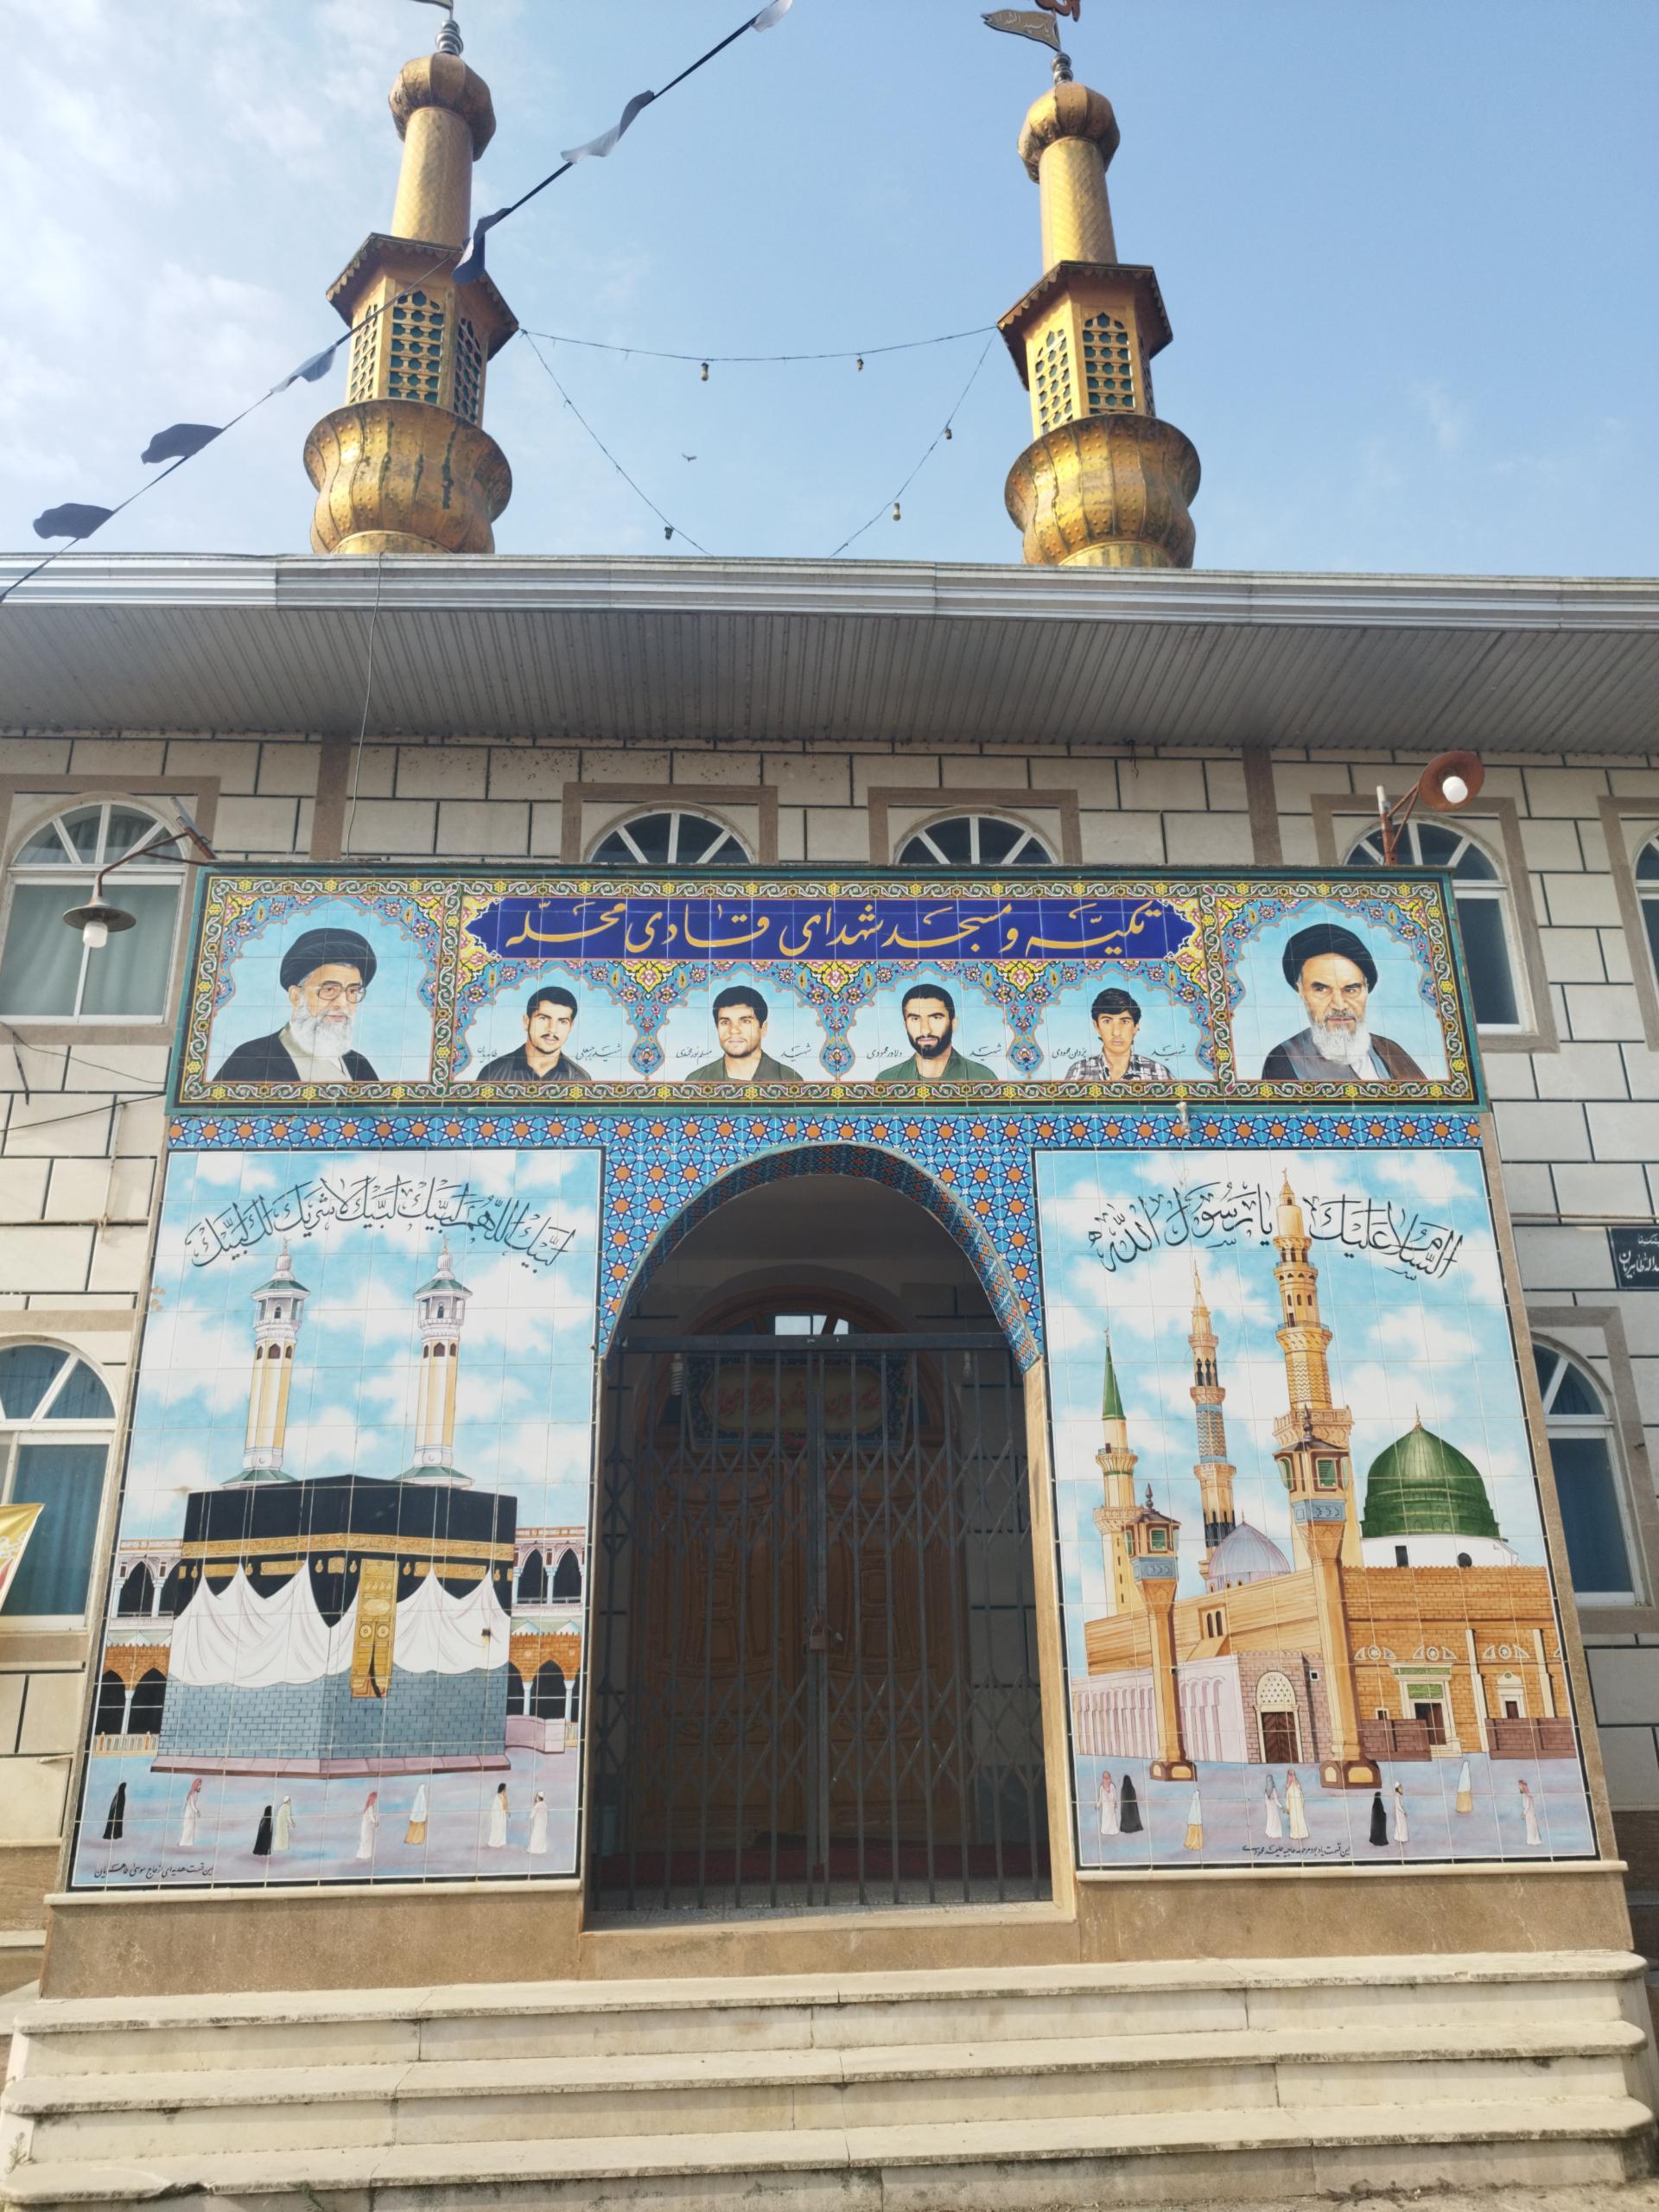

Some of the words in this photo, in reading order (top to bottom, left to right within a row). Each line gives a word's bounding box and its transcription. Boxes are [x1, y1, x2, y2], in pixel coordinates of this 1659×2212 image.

[779, 903, 884, 957] شهدای
[880, 903, 1012, 952] مسجد
[1000, 927, 1019, 953] و
[592, 1043, 622, 1062] شهید
[780, 1042, 812, 1062] شهید
[969, 1042, 1001, 1062] شهید
[1151, 1043, 1186, 1061] شهید
[1324, 1842, 1341, 1854] قسمت
[1339, 1846, 1351, 1857] این
[187, 1862, 204, 1873] قسمت
[202, 1866, 214, 1876] این
